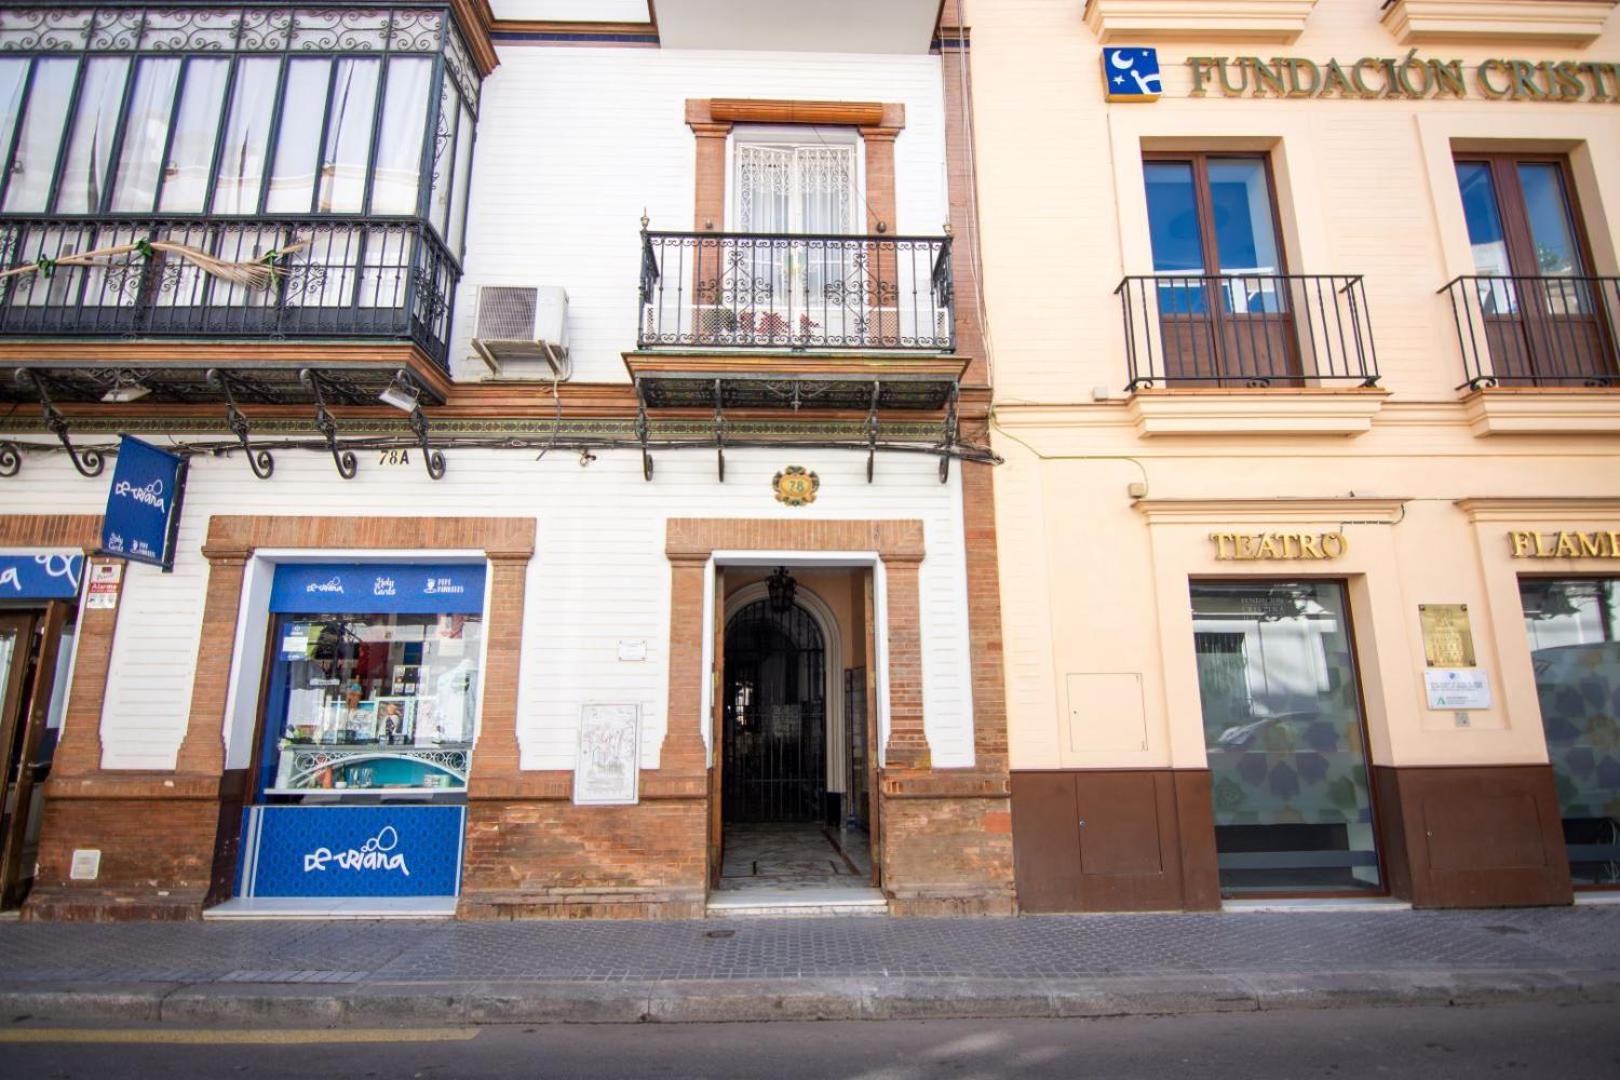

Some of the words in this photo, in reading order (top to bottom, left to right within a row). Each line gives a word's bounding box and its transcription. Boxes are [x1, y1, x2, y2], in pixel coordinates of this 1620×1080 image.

[1184, 47, 1468, 100] FUNDACIÓN
[379, 448, 410, 465] 78A
[1208, 531, 1348, 561] TEATRO
